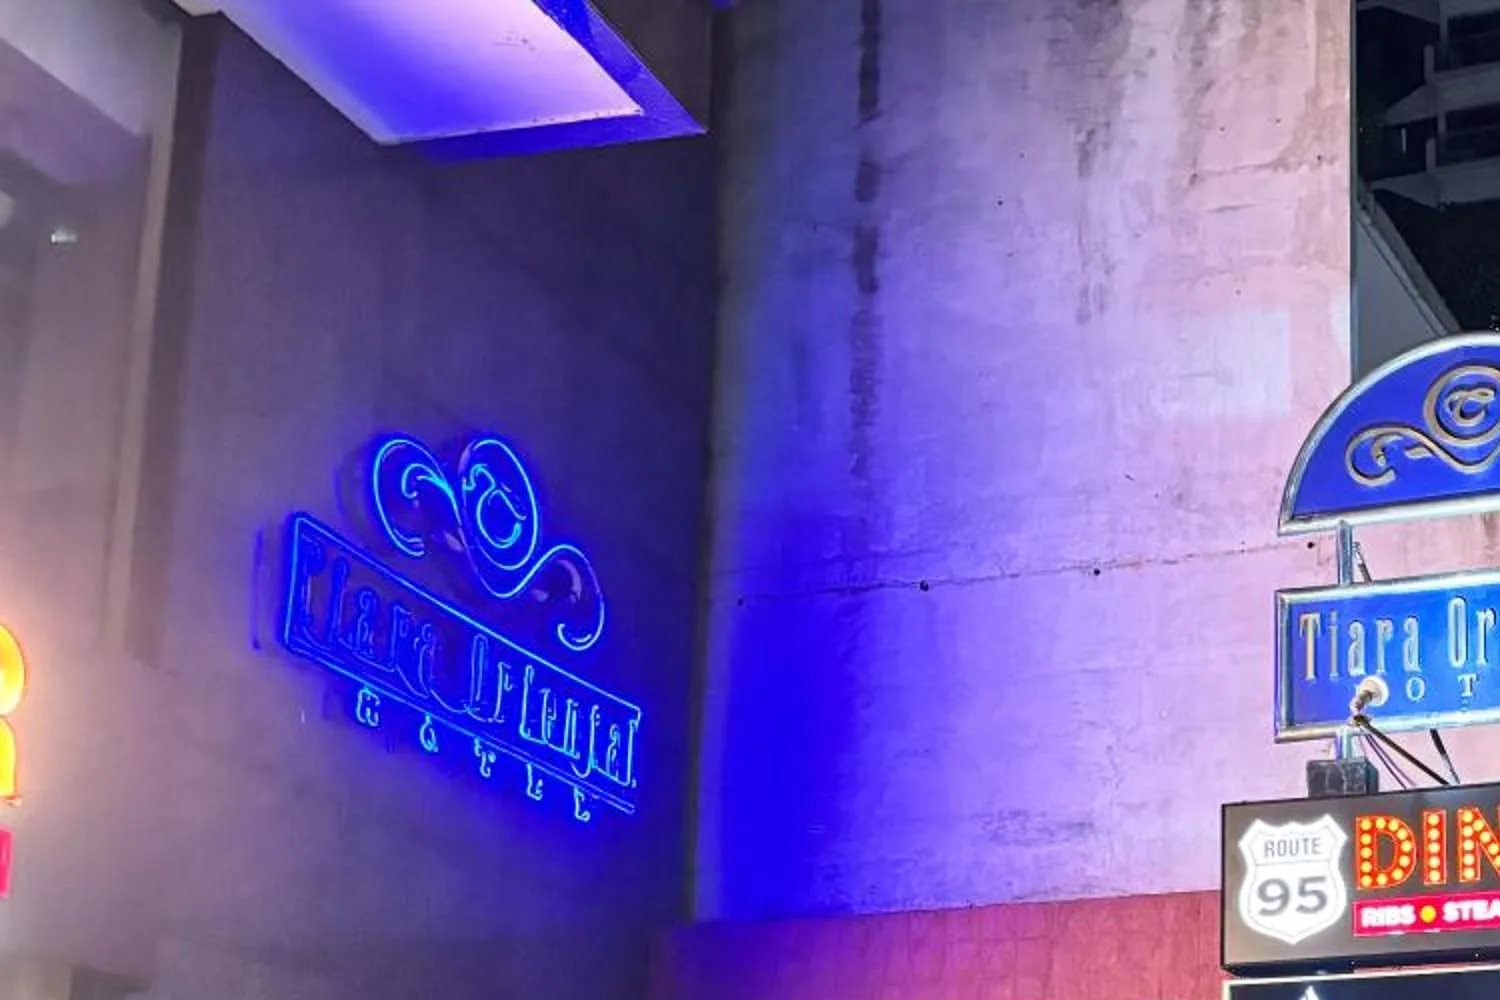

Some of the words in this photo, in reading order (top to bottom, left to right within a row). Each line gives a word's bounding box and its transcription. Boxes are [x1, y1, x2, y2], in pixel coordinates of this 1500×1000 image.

[1299, 609, 1423, 682] Tiara
[1263, 836, 1322, 859] ROUTE
[1256, 875, 1328, 917] 95
[1361, 905, 1416, 928] RIBS
